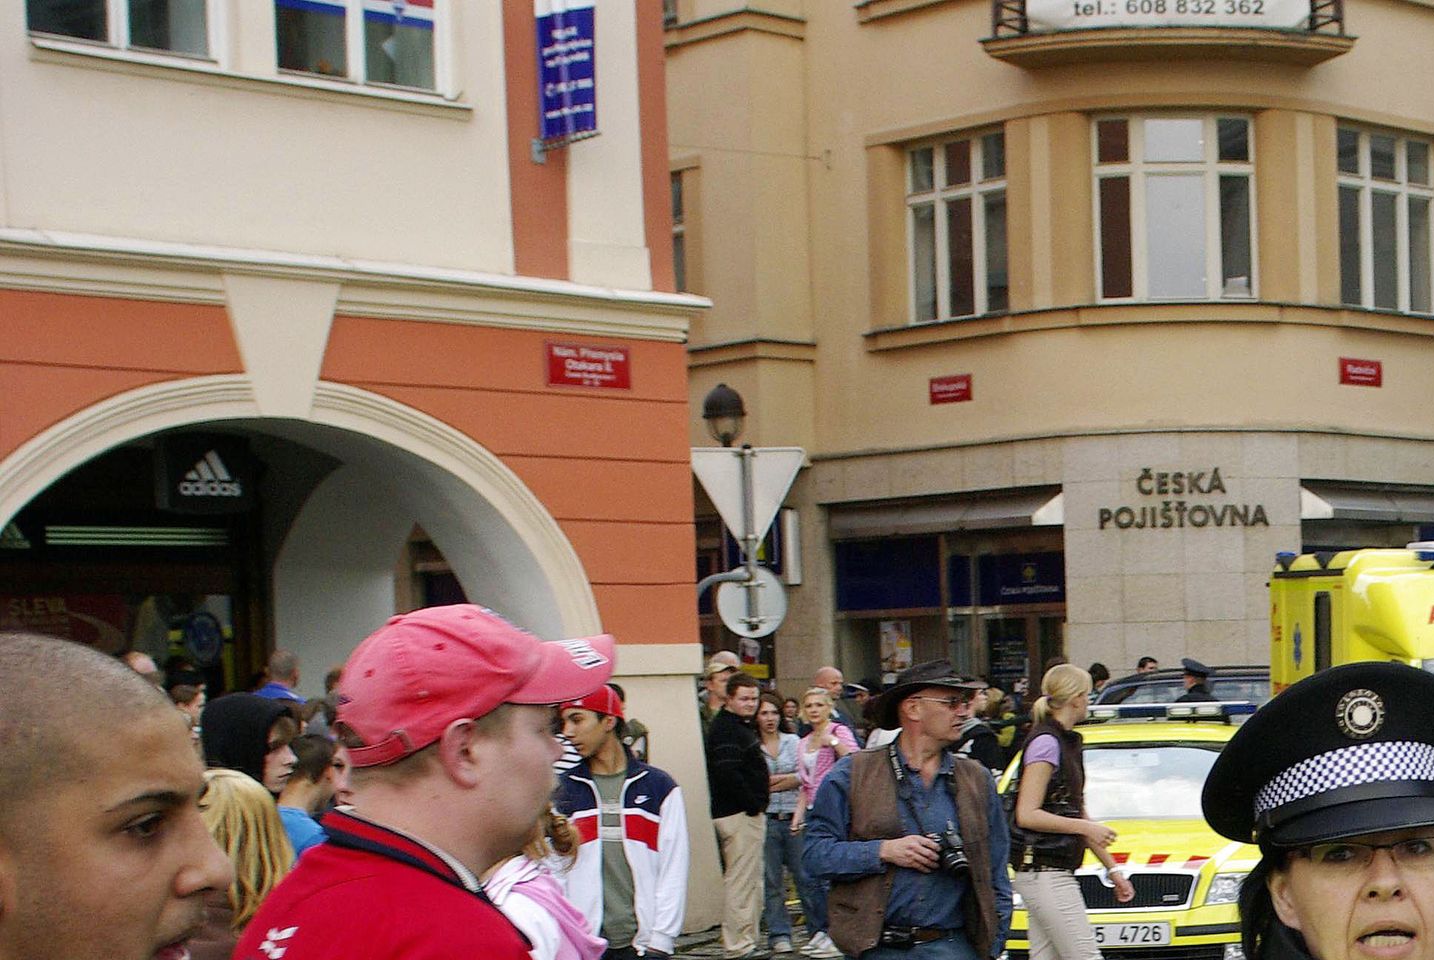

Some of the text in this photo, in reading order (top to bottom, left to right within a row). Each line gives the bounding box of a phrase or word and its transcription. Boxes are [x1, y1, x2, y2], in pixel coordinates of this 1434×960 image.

[1074, 0, 1265, 16] tel.: 608 832 362
[179, 481, 242, 497] adidas
[1137, 467, 1226, 496] ČESKÁ
[1099, 501, 1270, 530] POJIŠŤOVNA
[1119, 925, 1162, 943] 4726
